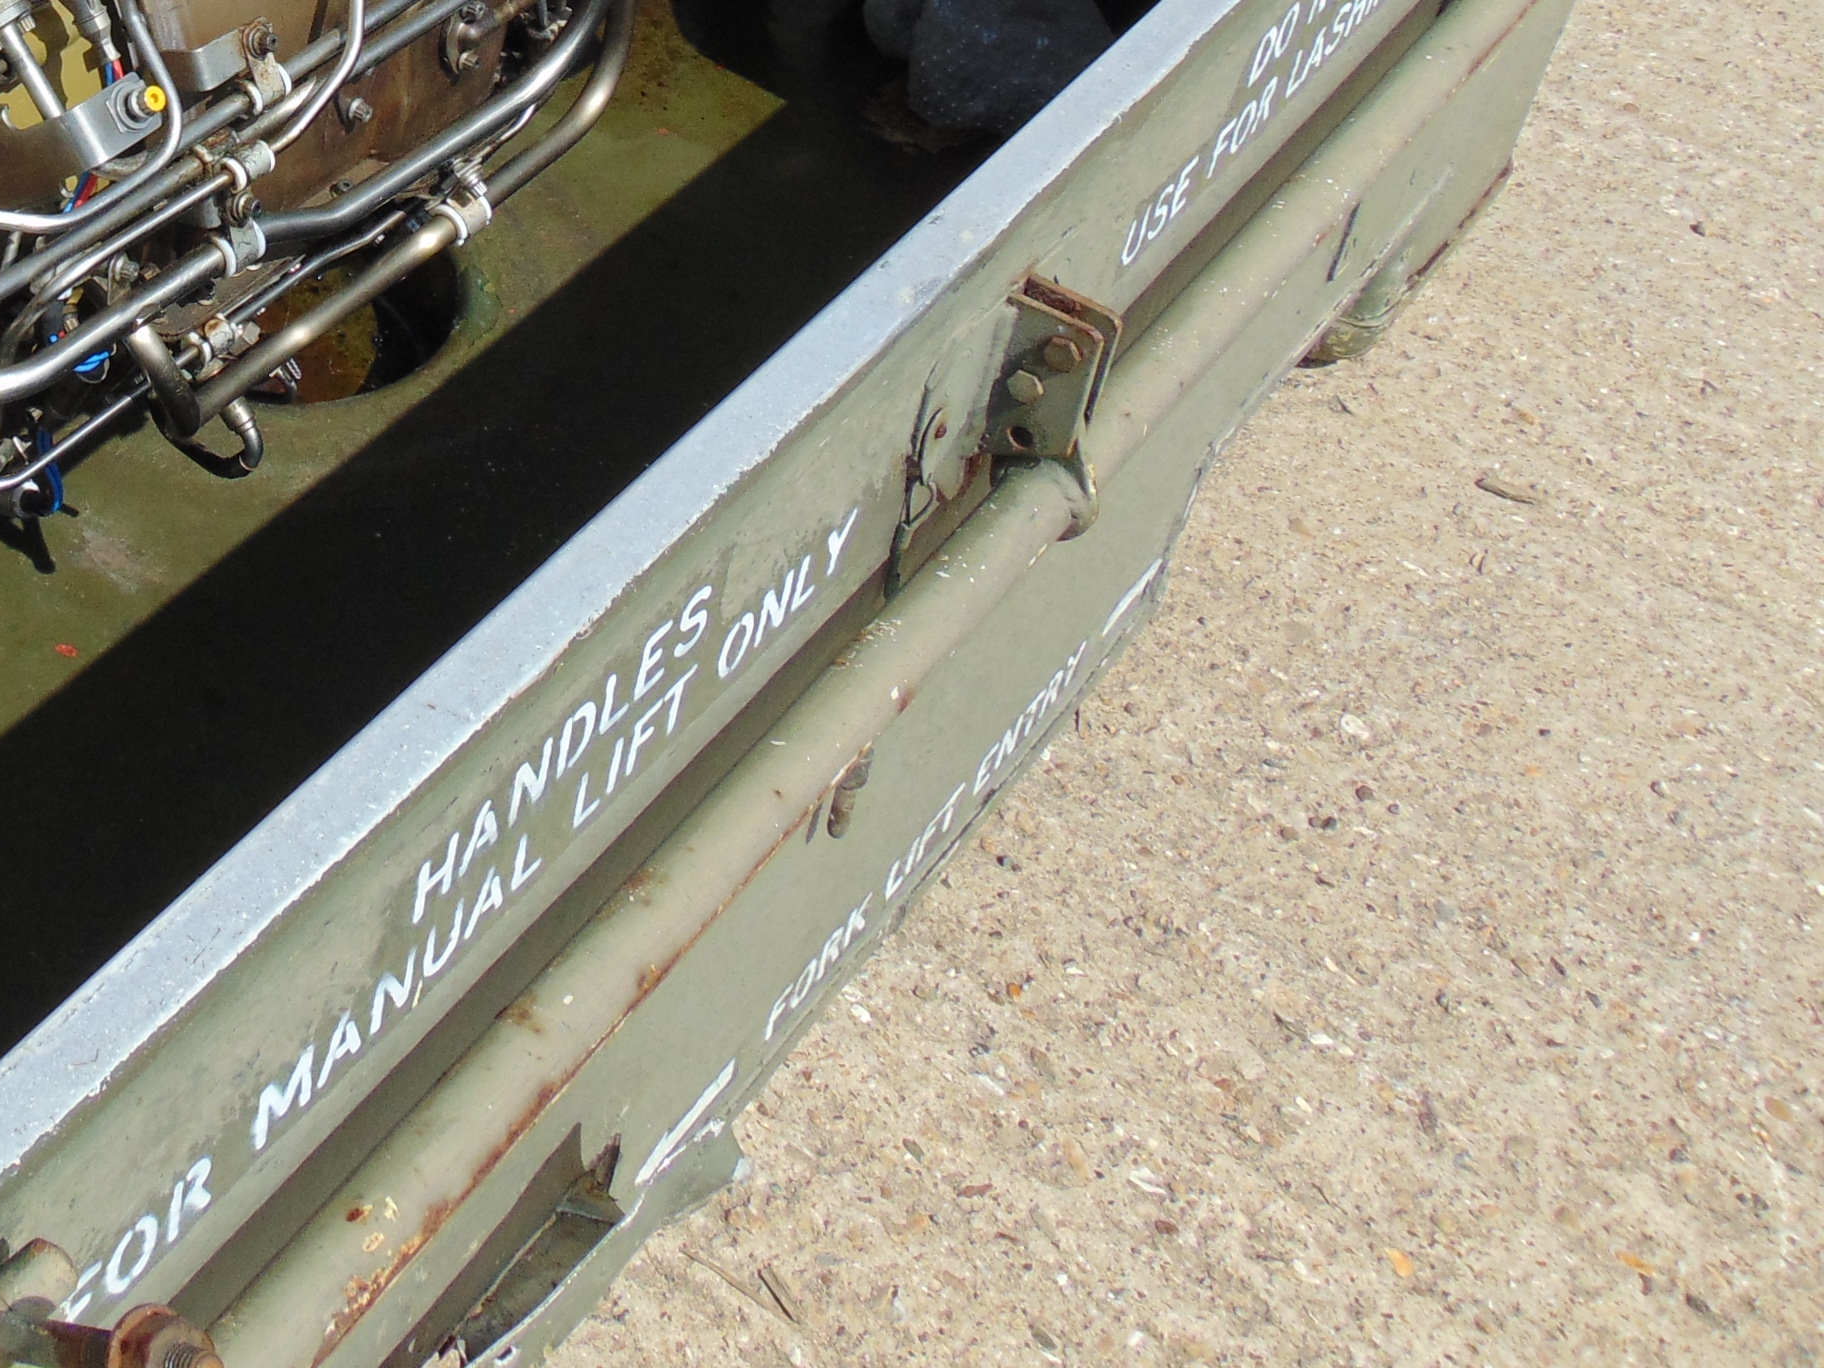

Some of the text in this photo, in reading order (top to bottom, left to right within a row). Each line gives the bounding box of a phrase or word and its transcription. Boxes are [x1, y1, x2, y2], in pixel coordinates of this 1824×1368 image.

[1120, 155, 1200, 266] USE
[1206, 76, 1278, 180] FOR
[1248, 2, 1300, 88] DO
[252, 834, 542, 1151] MANUAL
[572, 663, 699, 830] LIFT
[717, 507, 859, 680] ONLY
[412, 584, 713, 924] HANDLES
[764, 640, 1087, 1041] FORK LIFT ENTRY
